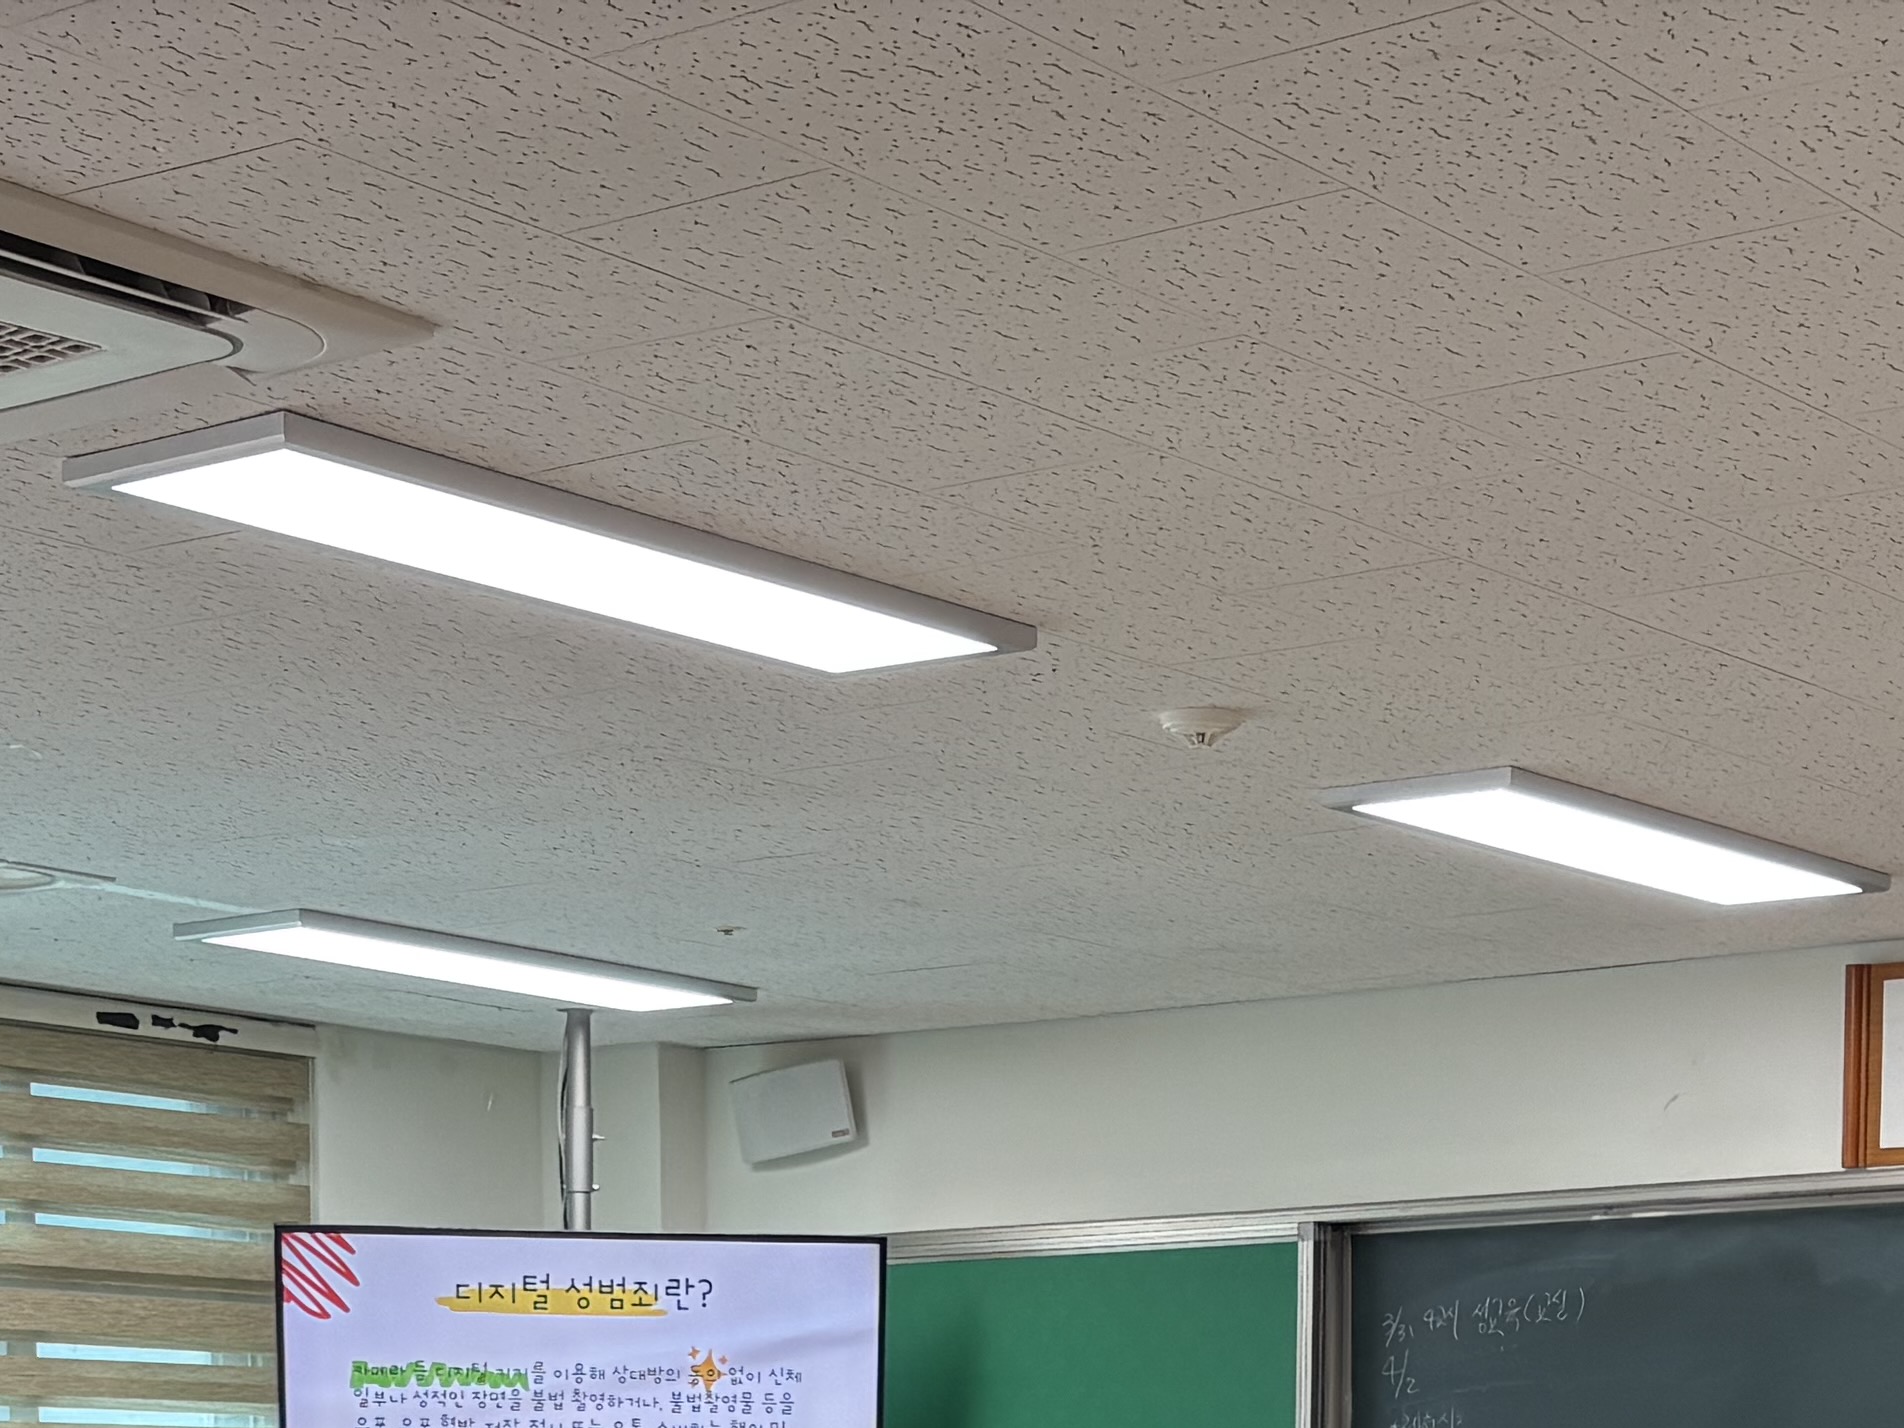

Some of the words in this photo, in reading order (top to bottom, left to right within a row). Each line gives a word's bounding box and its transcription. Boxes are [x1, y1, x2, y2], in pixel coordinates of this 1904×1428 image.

[456, 1273, 550, 1311] 디지털
[565, 1275, 713, 1311] 성범죄란?
[553, 1362, 605, 1385] 이용해
[612, 1365, 680, 1385] 상대방의
[728, 1366, 761, 1386] 없이
[769, 1367, 802, 1386] 신체
[353, 1387, 408, 1409] 일부나
[413, 1390, 465, 1409] 성적인
[472, 1388, 522, 1412] 장면을
[531, 1388, 565, 1411] 불법
[761, 1392, 795, 1416] 등을
